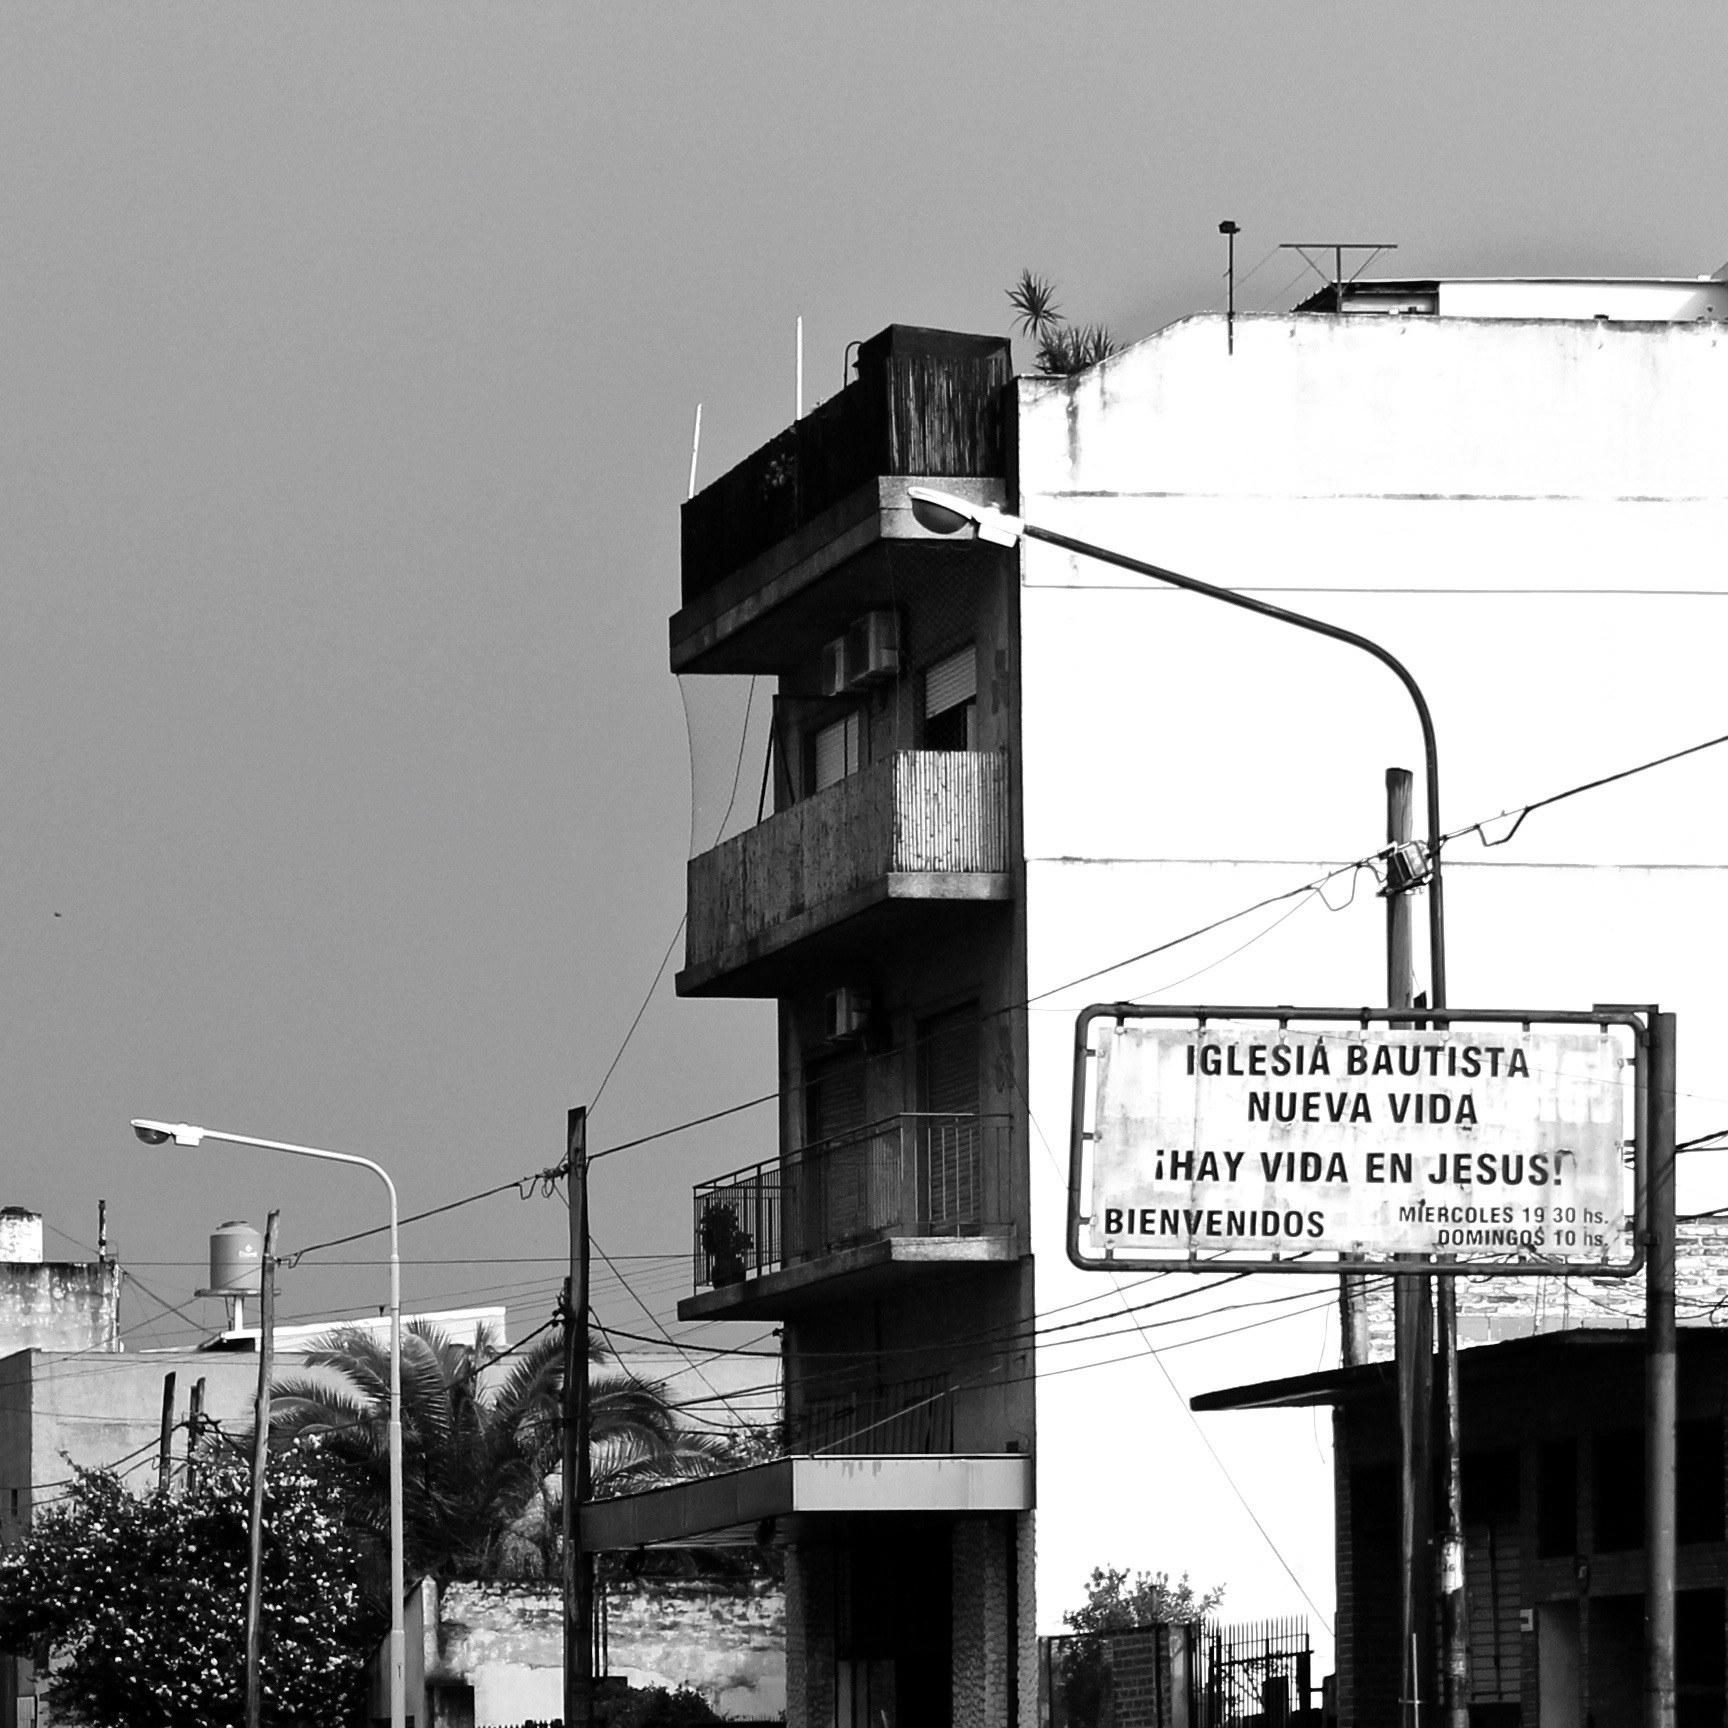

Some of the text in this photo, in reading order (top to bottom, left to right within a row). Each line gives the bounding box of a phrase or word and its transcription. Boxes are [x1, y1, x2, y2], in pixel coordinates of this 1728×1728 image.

[1186, 1043, 1531, 1080] IGLESIA BAUTISTA
[1248, 1091, 1479, 1126] NUEVA VIDA
[1154, 1149, 1564, 1187] ¡HAY VIDA EN JESUS!
[1103, 1207, 1325, 1239] BIENVENIDOS
[1398, 1206, 1514, 1224] MIERCOLES
[1552, 1206, 1576, 1223] 30
[1583, 1207, 1609, 1224] hs.
[1437, 1229, 1546, 1246] DOMINGOS
[1554, 1229, 1576, 1246] 10
